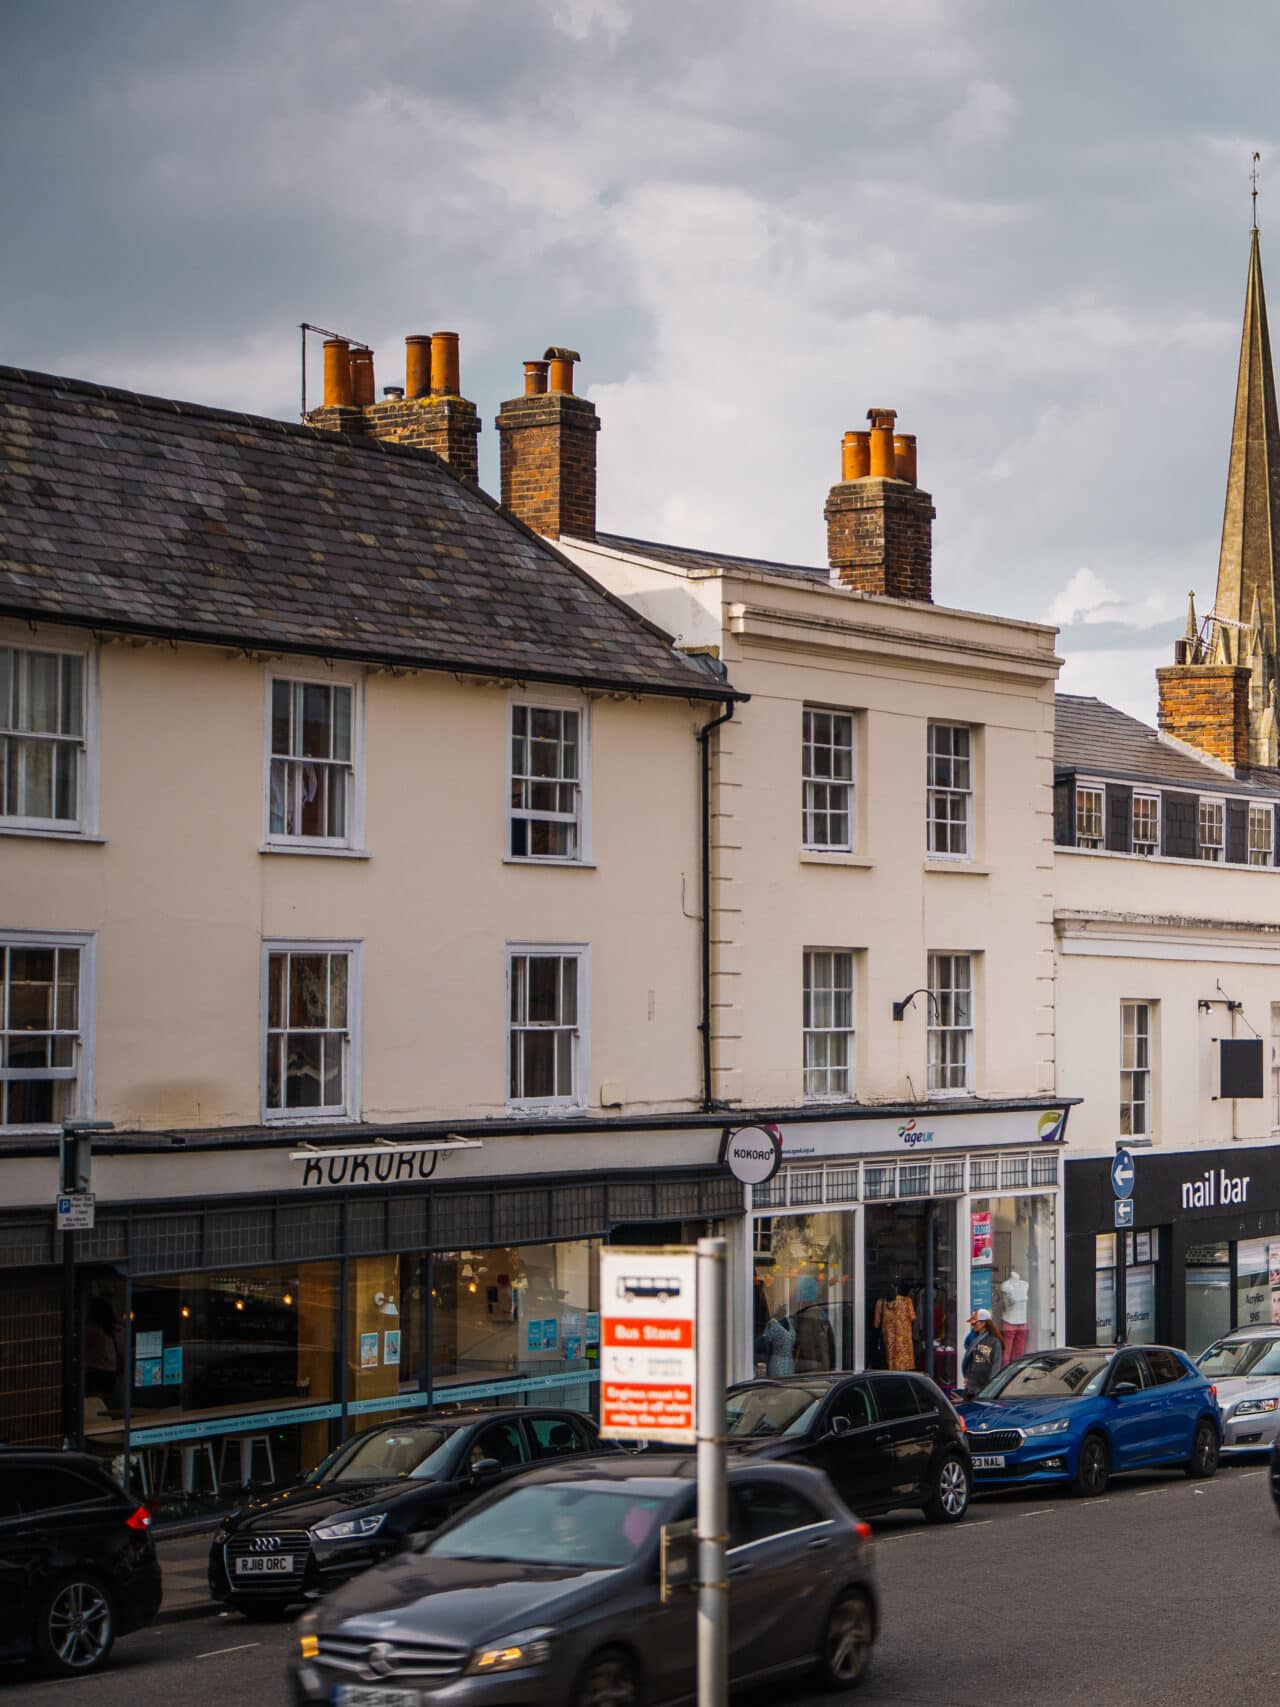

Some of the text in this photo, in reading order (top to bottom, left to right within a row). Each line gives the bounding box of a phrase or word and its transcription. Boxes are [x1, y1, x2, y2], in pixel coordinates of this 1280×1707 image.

[733, 1148, 770, 1161] KOKORO
[1181, 1168, 1251, 1209] nail bar
[614, 1323, 682, 1342] Bus Stand
[241, 1557, 287, 1572] RJ18 ORC
